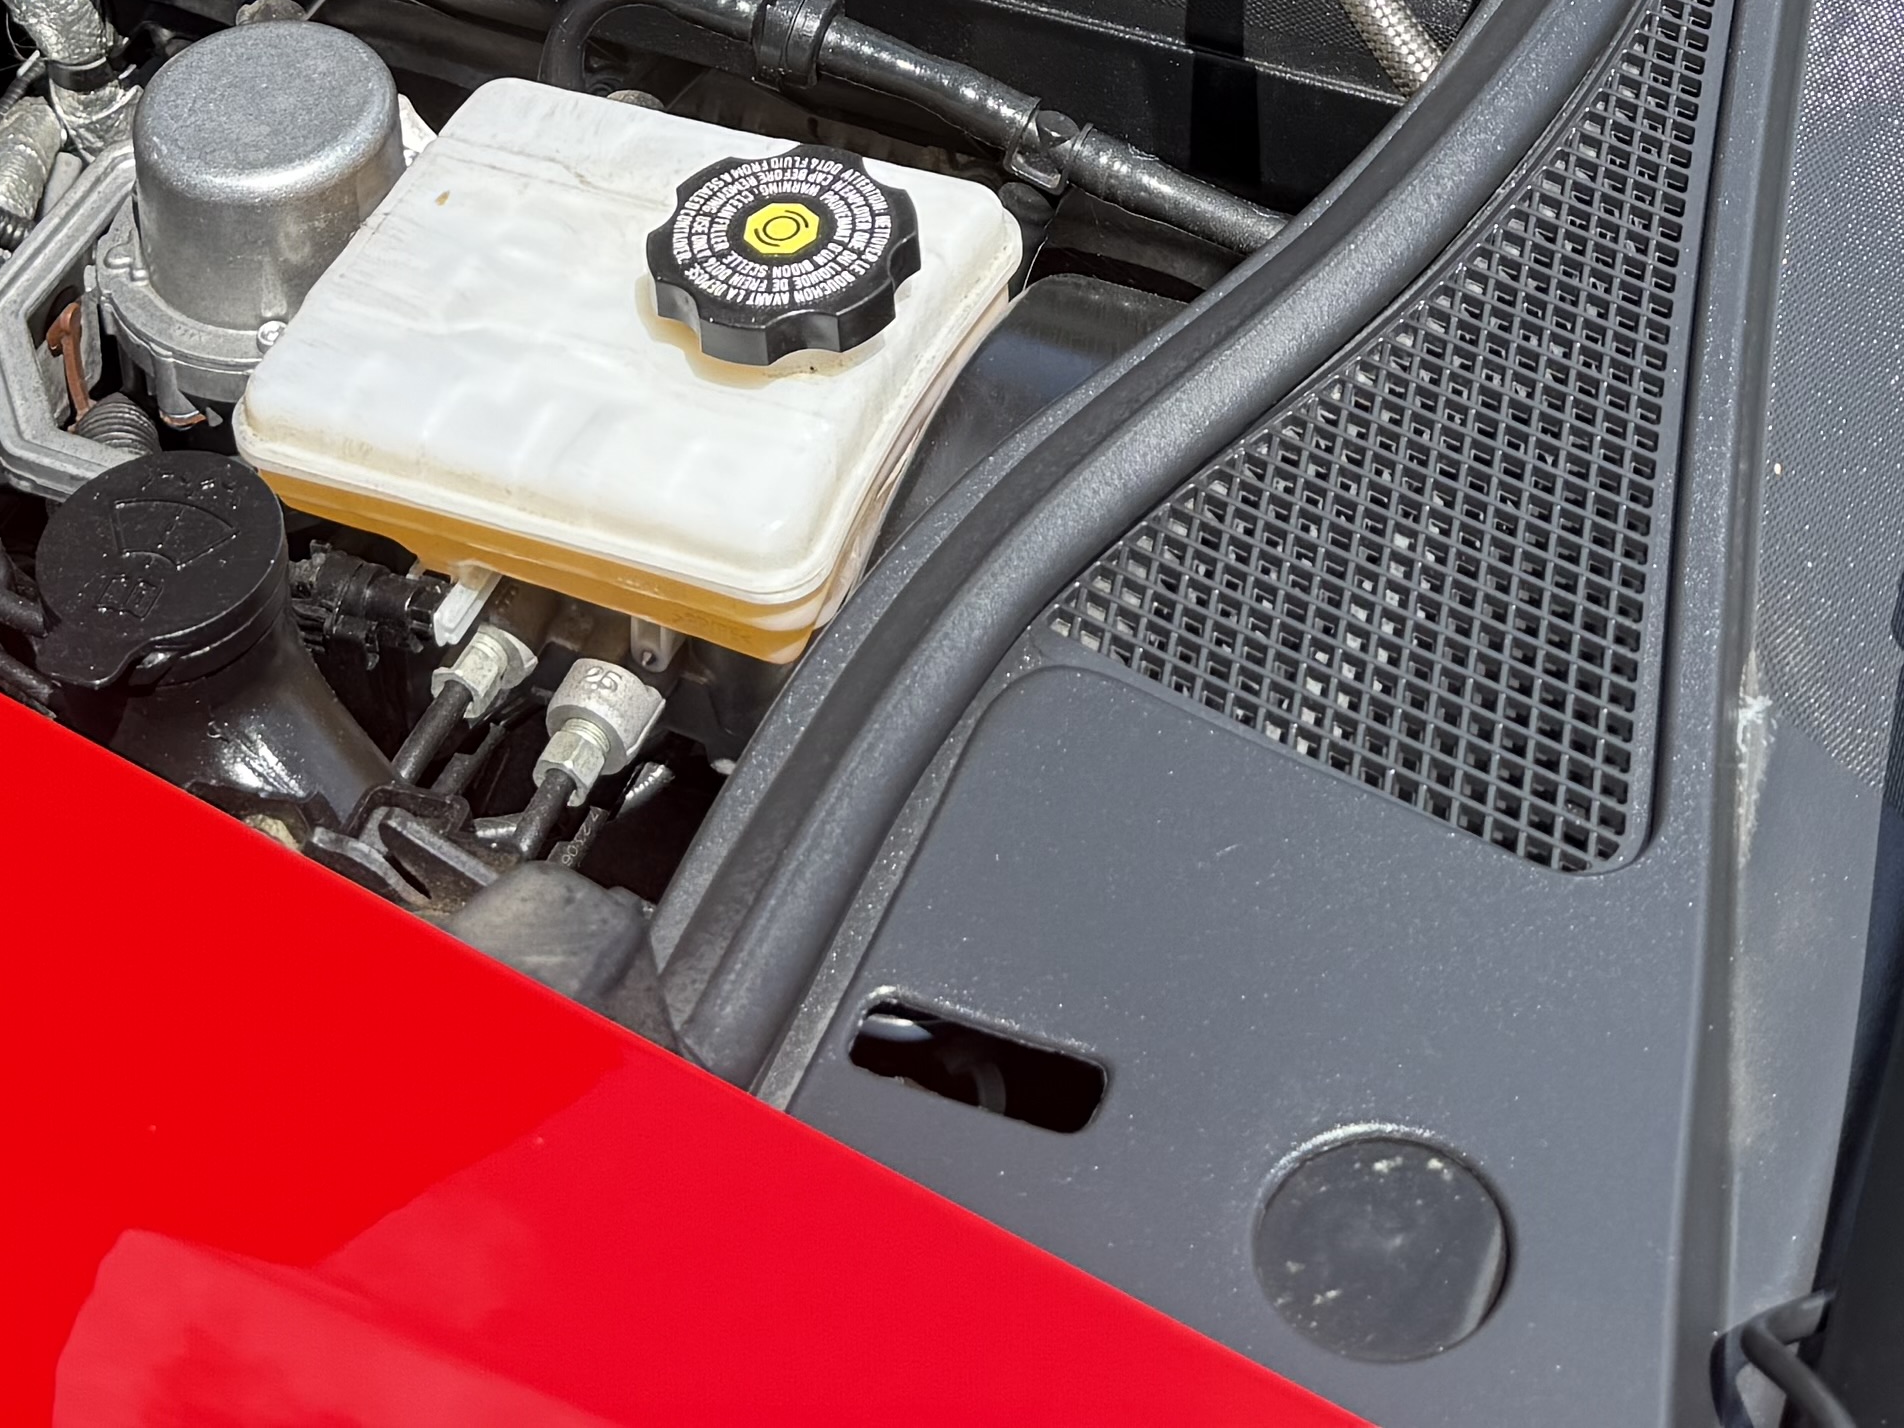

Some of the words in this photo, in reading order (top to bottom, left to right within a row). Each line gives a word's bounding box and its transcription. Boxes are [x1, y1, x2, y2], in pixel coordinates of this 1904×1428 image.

[730, 160, 769, 177] FROM
[770, 156, 809, 169] FLUID
[719, 172, 733, 183] A
[757, 168, 808, 184] BEFORE
[807, 171, 834, 187] CAP
[684, 177, 725, 209] SEALED
[717, 190, 754, 219] CLEAN
[691, 216, 711, 233] USE
[710, 218, 730, 252] FILLER
[691, 234, 713, 259] ONLY
[836, 249, 858, 267] DU
[772, 259, 815, 278] BIDON
[792, 262, 842, 289] LIQUIDE
[849, 259, 871, 276] LE
[727, 273, 768, 291] FREIN
[772, 278, 789, 292] DE
[793, 270, 856, 303] BOUCHON
[726, 288, 746, 303] LA
[745, 291, 790, 306] AVANT
[583, 665, 623, 693] 25
